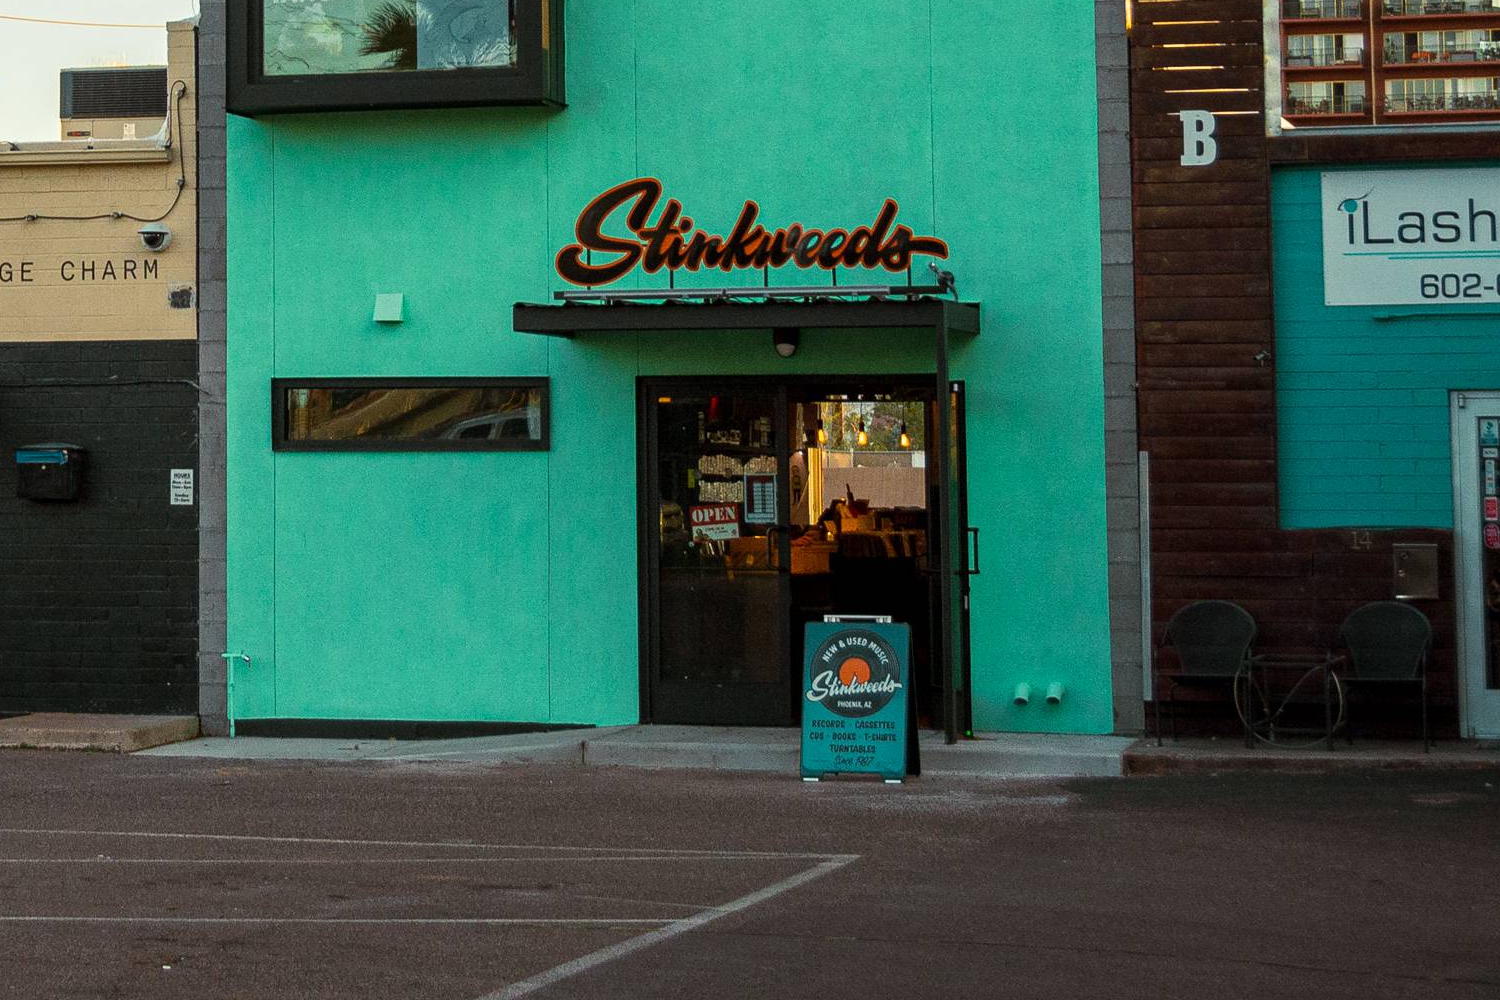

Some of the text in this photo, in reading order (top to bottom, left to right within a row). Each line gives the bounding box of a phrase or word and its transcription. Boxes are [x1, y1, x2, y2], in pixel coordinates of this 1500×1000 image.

[1180, 110, 1217, 166] B
[555, 177, 949, 287] Stinkweeds
[60, 258, 159, 281] CHARM
[1420, 273, 1500, 299] 602-
[692, 506, 736, 523] OPEN
[1350, 529, 1373, 550] 14
[822, 643, 839, 663] NEW
[846, 637, 868, 647] USED
[868, 641, 889, 665] MUSIC
[806, 670, 903, 701] Stinkweeds
[812, 720, 895, 729] RECORDS CASSETTES
[829, 743, 876, 754] TURNTABLES
[832, 732, 857, 741] BOOKS
[864, 733, 897, 742] T-SHIRTS
